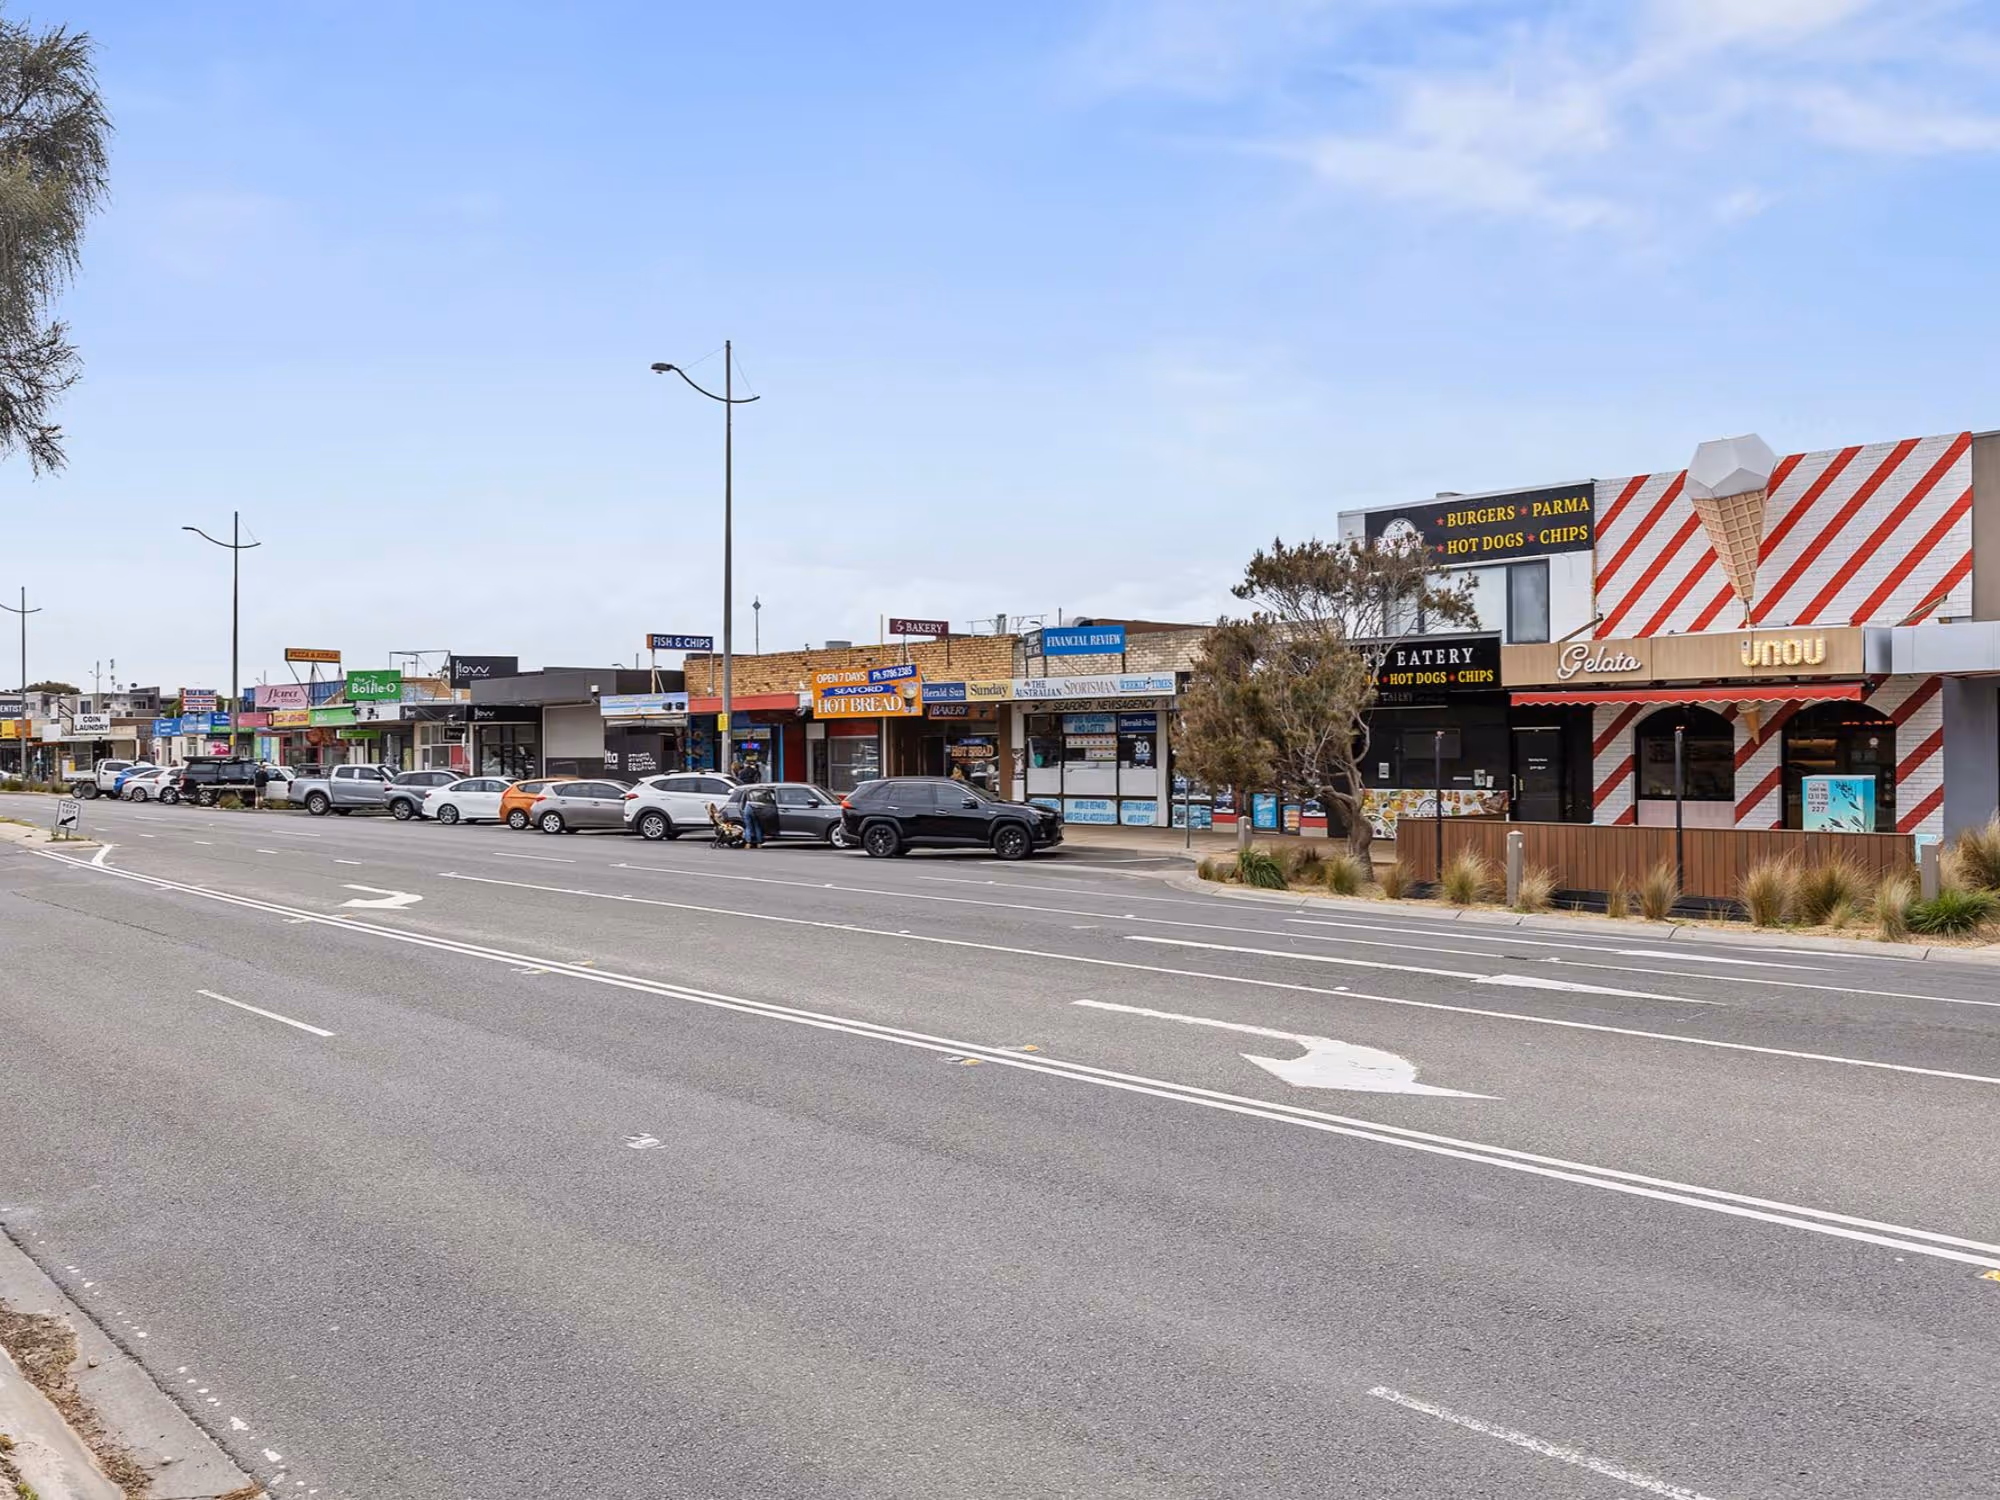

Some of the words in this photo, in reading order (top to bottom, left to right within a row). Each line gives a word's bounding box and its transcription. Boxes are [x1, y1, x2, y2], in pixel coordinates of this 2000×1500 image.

[1447, 506, 1515, 528] BURGERS
[1532, 497, 1590, 517] PARMA
[1447, 538, 1479, 554] HOT
[1482, 532, 1524, 550] DOGS
[1539, 525, 1588, 544] CHIPS
[905, 622, 942, 633] BAKERY
[653, 636, 672, 646] FISH
[675, 638, 682, 647] &
[684, 638, 711, 648] CHIPS
[1046, 635, 1088, 647] FINANCIAL
[1090, 634, 1121, 645] REVIEW
[1396, 648, 1474, 666] EATERY
[1557, 643, 1642, 680] Gelato
[816, 673, 839, 684] OPEN
[839, 673, 845, 682] 7
[845, 671, 866, 682] DAYS
[1389, 673, 1414, 684] HOT
[1416, 672, 1447, 684] DOGS
[1458, 670, 1494, 682] CHIPS
[834, 685, 883, 695] SEAFORD
[970, 683, 1008, 697] Sunday
[1031, 680, 1047, 688] THE
[923, 688, 947, 697] Herald
[949, 688, 965, 697] Sun
[1015, 688, 1062, 697] AUSTRALIAN
[0, 704, 22, 713] ENTIST
[817, 698, 849, 713] HOT
[850, 696, 902, 712] BREAD
[932, 705, 968, 715] BAKERY
[1053, 700, 1092, 711] SEAFORD
[1097, 699, 1158, 711] NEWSAGENCY
